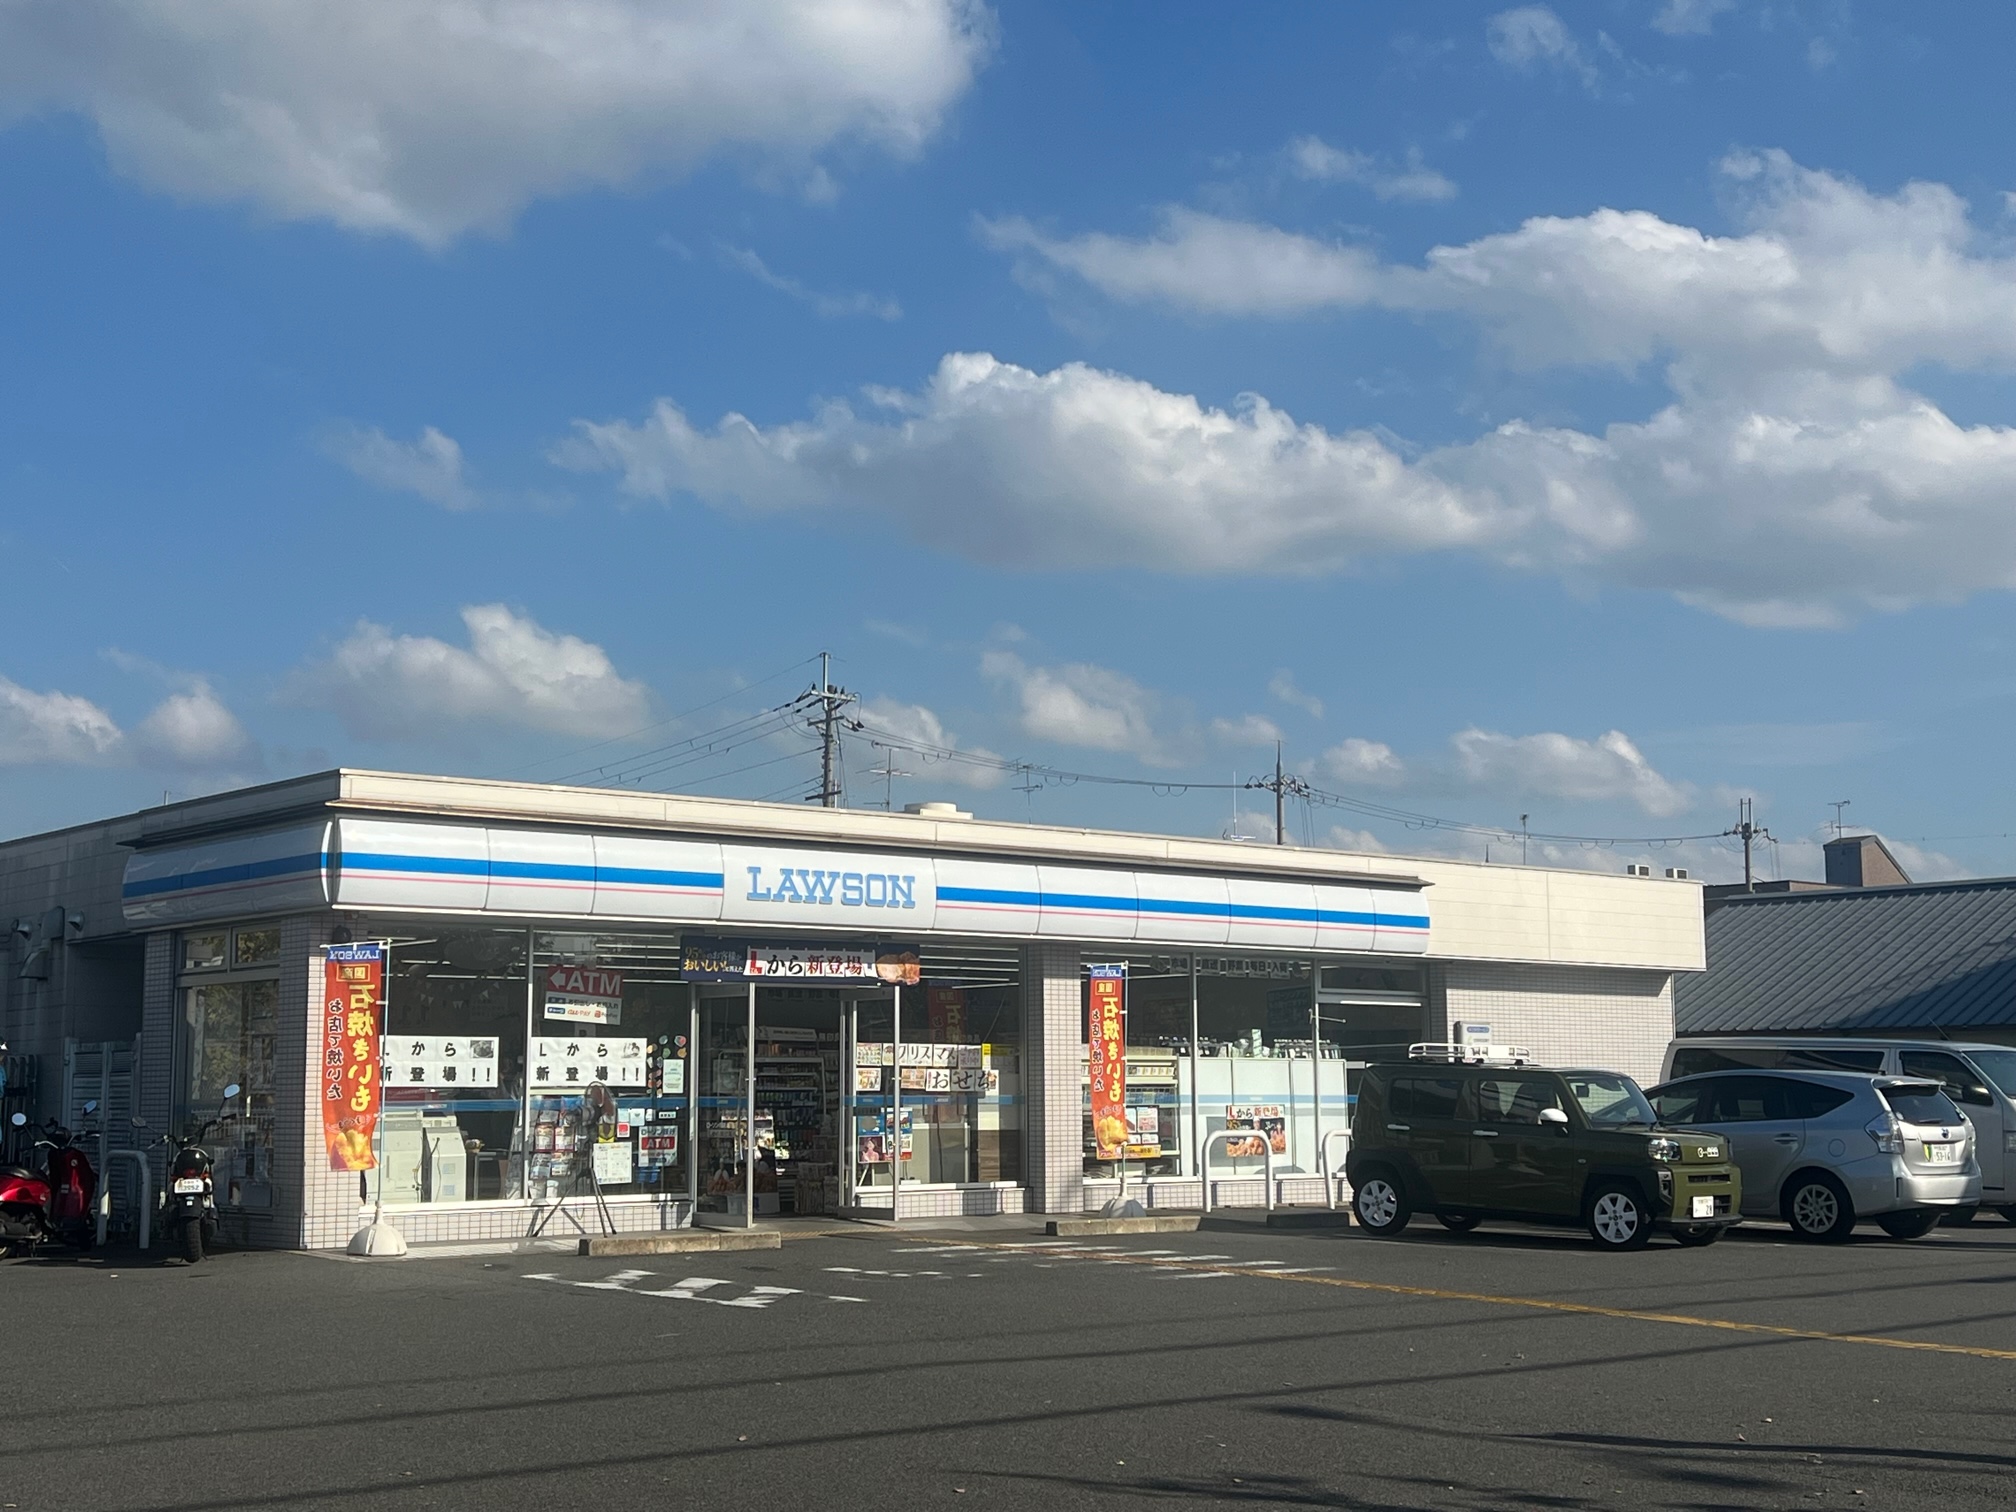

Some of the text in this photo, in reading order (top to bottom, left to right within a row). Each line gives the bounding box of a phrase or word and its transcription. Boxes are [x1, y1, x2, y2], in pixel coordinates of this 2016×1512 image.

[746, 866, 916, 909] LAWSON
[566, 970, 621, 995] ATM
[539, 1042, 608, 1057] Lから
[932, 1071, 990, 1091] おせち
[646, 1138, 670, 1149] ATM
